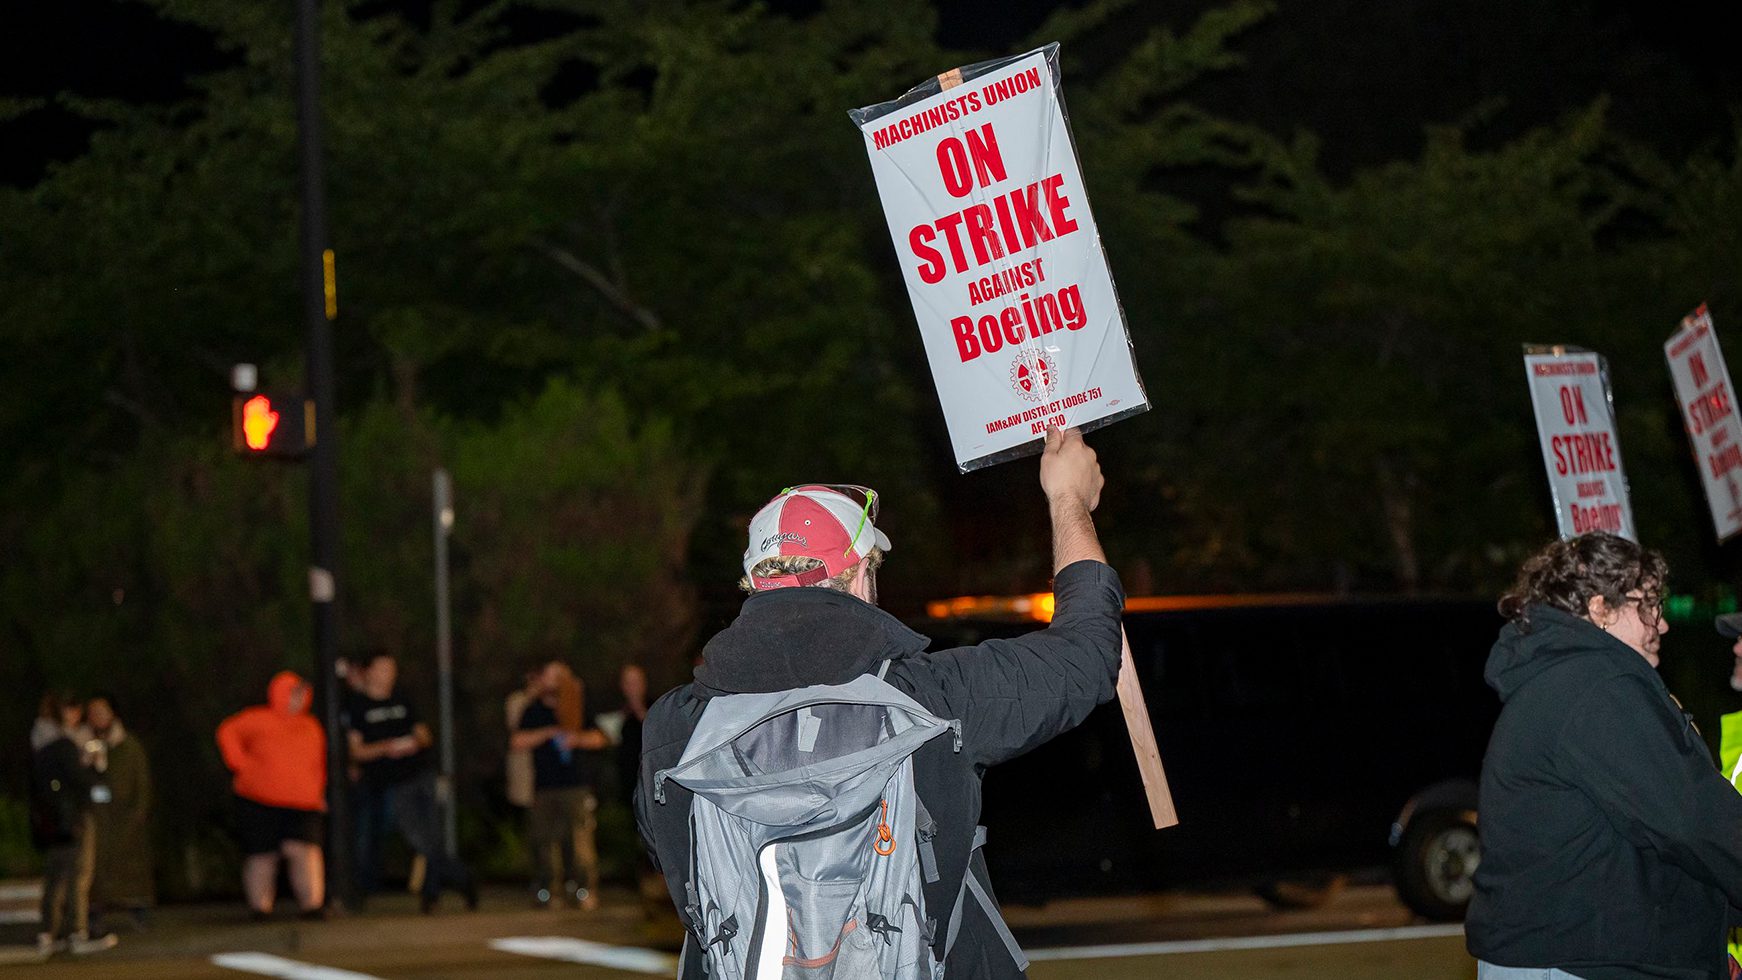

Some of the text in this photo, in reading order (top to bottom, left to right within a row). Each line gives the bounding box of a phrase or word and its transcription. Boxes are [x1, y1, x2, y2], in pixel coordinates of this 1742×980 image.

[873, 67, 1041, 150] MACHINISTS UNION
[936, 122, 1008, 198] ON
[908, 173, 1079, 285] STRIKE
[968, 258, 1045, 306] AGAINST
[950, 284, 1087, 363] Boeing
[985, 386, 1103, 434] IAM&AW DISTRICT LODGE 751
[1560, 384, 1588, 425] ON
[1552, 432, 1615, 476] STRIKE
